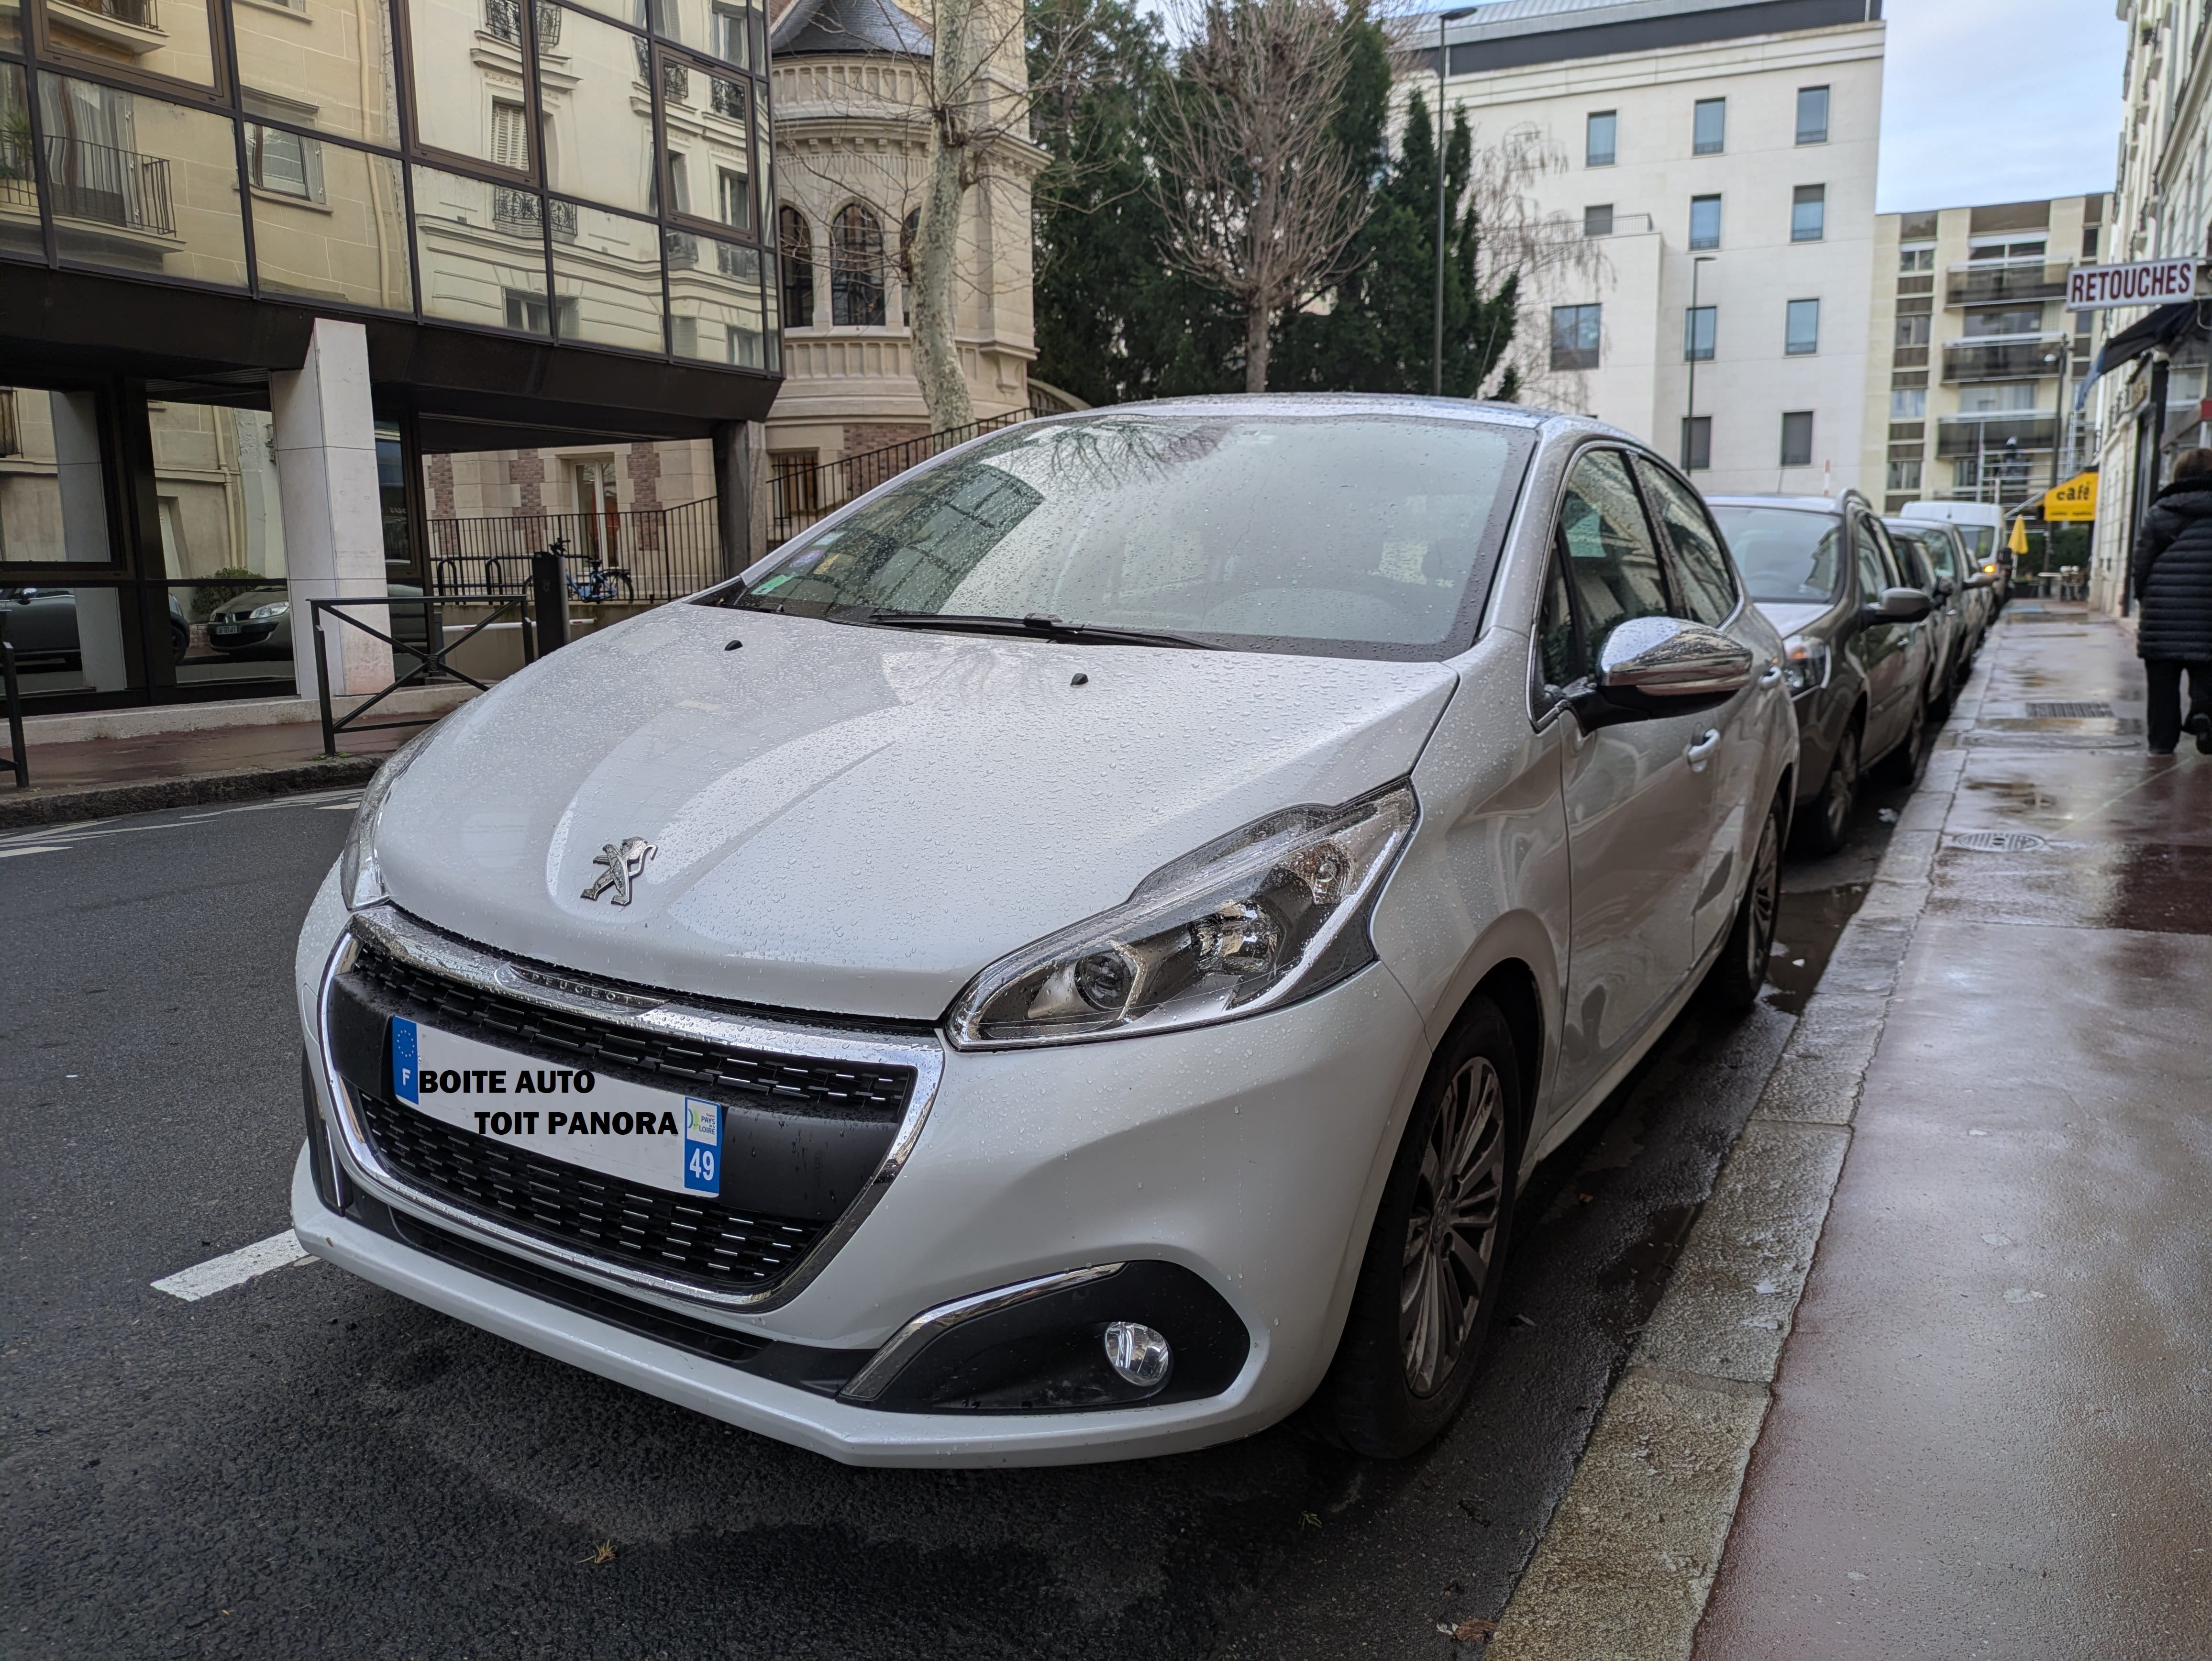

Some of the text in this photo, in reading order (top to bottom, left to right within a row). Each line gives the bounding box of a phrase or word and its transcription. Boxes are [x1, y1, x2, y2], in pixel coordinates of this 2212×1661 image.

[2071, 263, 2191, 303] RETOUCHES
[531, 974, 632, 1004] PEUGEOT
[402, 1068, 411, 1085] F
[699, 1125, 716, 1135] LOIRE
[701, 1116, 716, 1125] PAYS
[689, 1148, 715, 1181] 49
